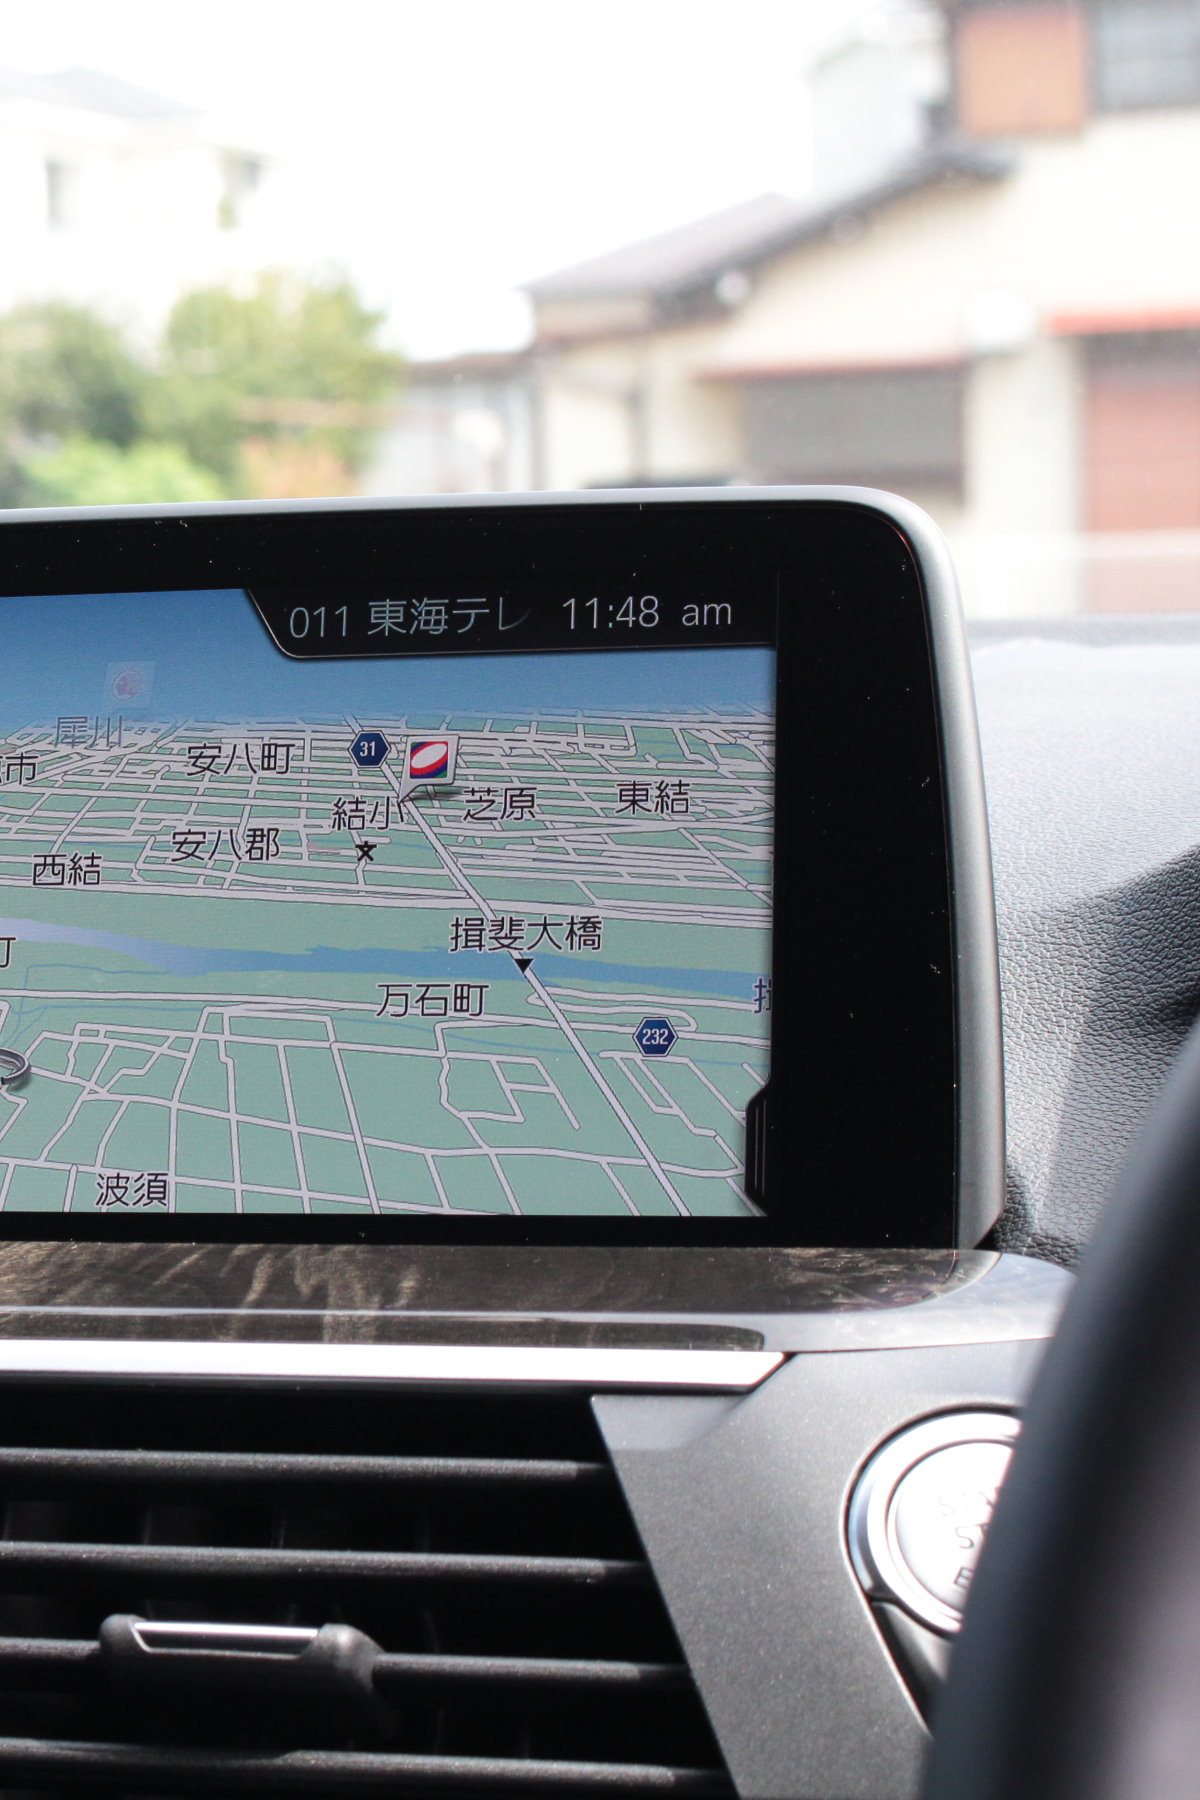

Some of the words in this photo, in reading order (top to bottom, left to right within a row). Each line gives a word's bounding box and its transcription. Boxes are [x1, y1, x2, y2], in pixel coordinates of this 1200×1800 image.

[289, 606, 349, 639] 011
[562, 595, 660, 629] 11:48
[681, 600, 732, 626] am
[53, 714, 123, 749] 犀川
[186, 742, 296, 776] 安八町
[359, 742, 377, 758] 31
[331, 796, 405, 831] 結小
[462, 787, 538, 822] 芝原
[615, 779, 691, 816] 東結
[171, 827, 280, 862] 安八郡
[33, 853, 102, 887] 西結
[450, 915, 603, 952] 揖斐大橋
[376, 982, 490, 1018] 万石町
[642, 1027, 669, 1047] 232
[95, 1172, 168, 1207] 波須
